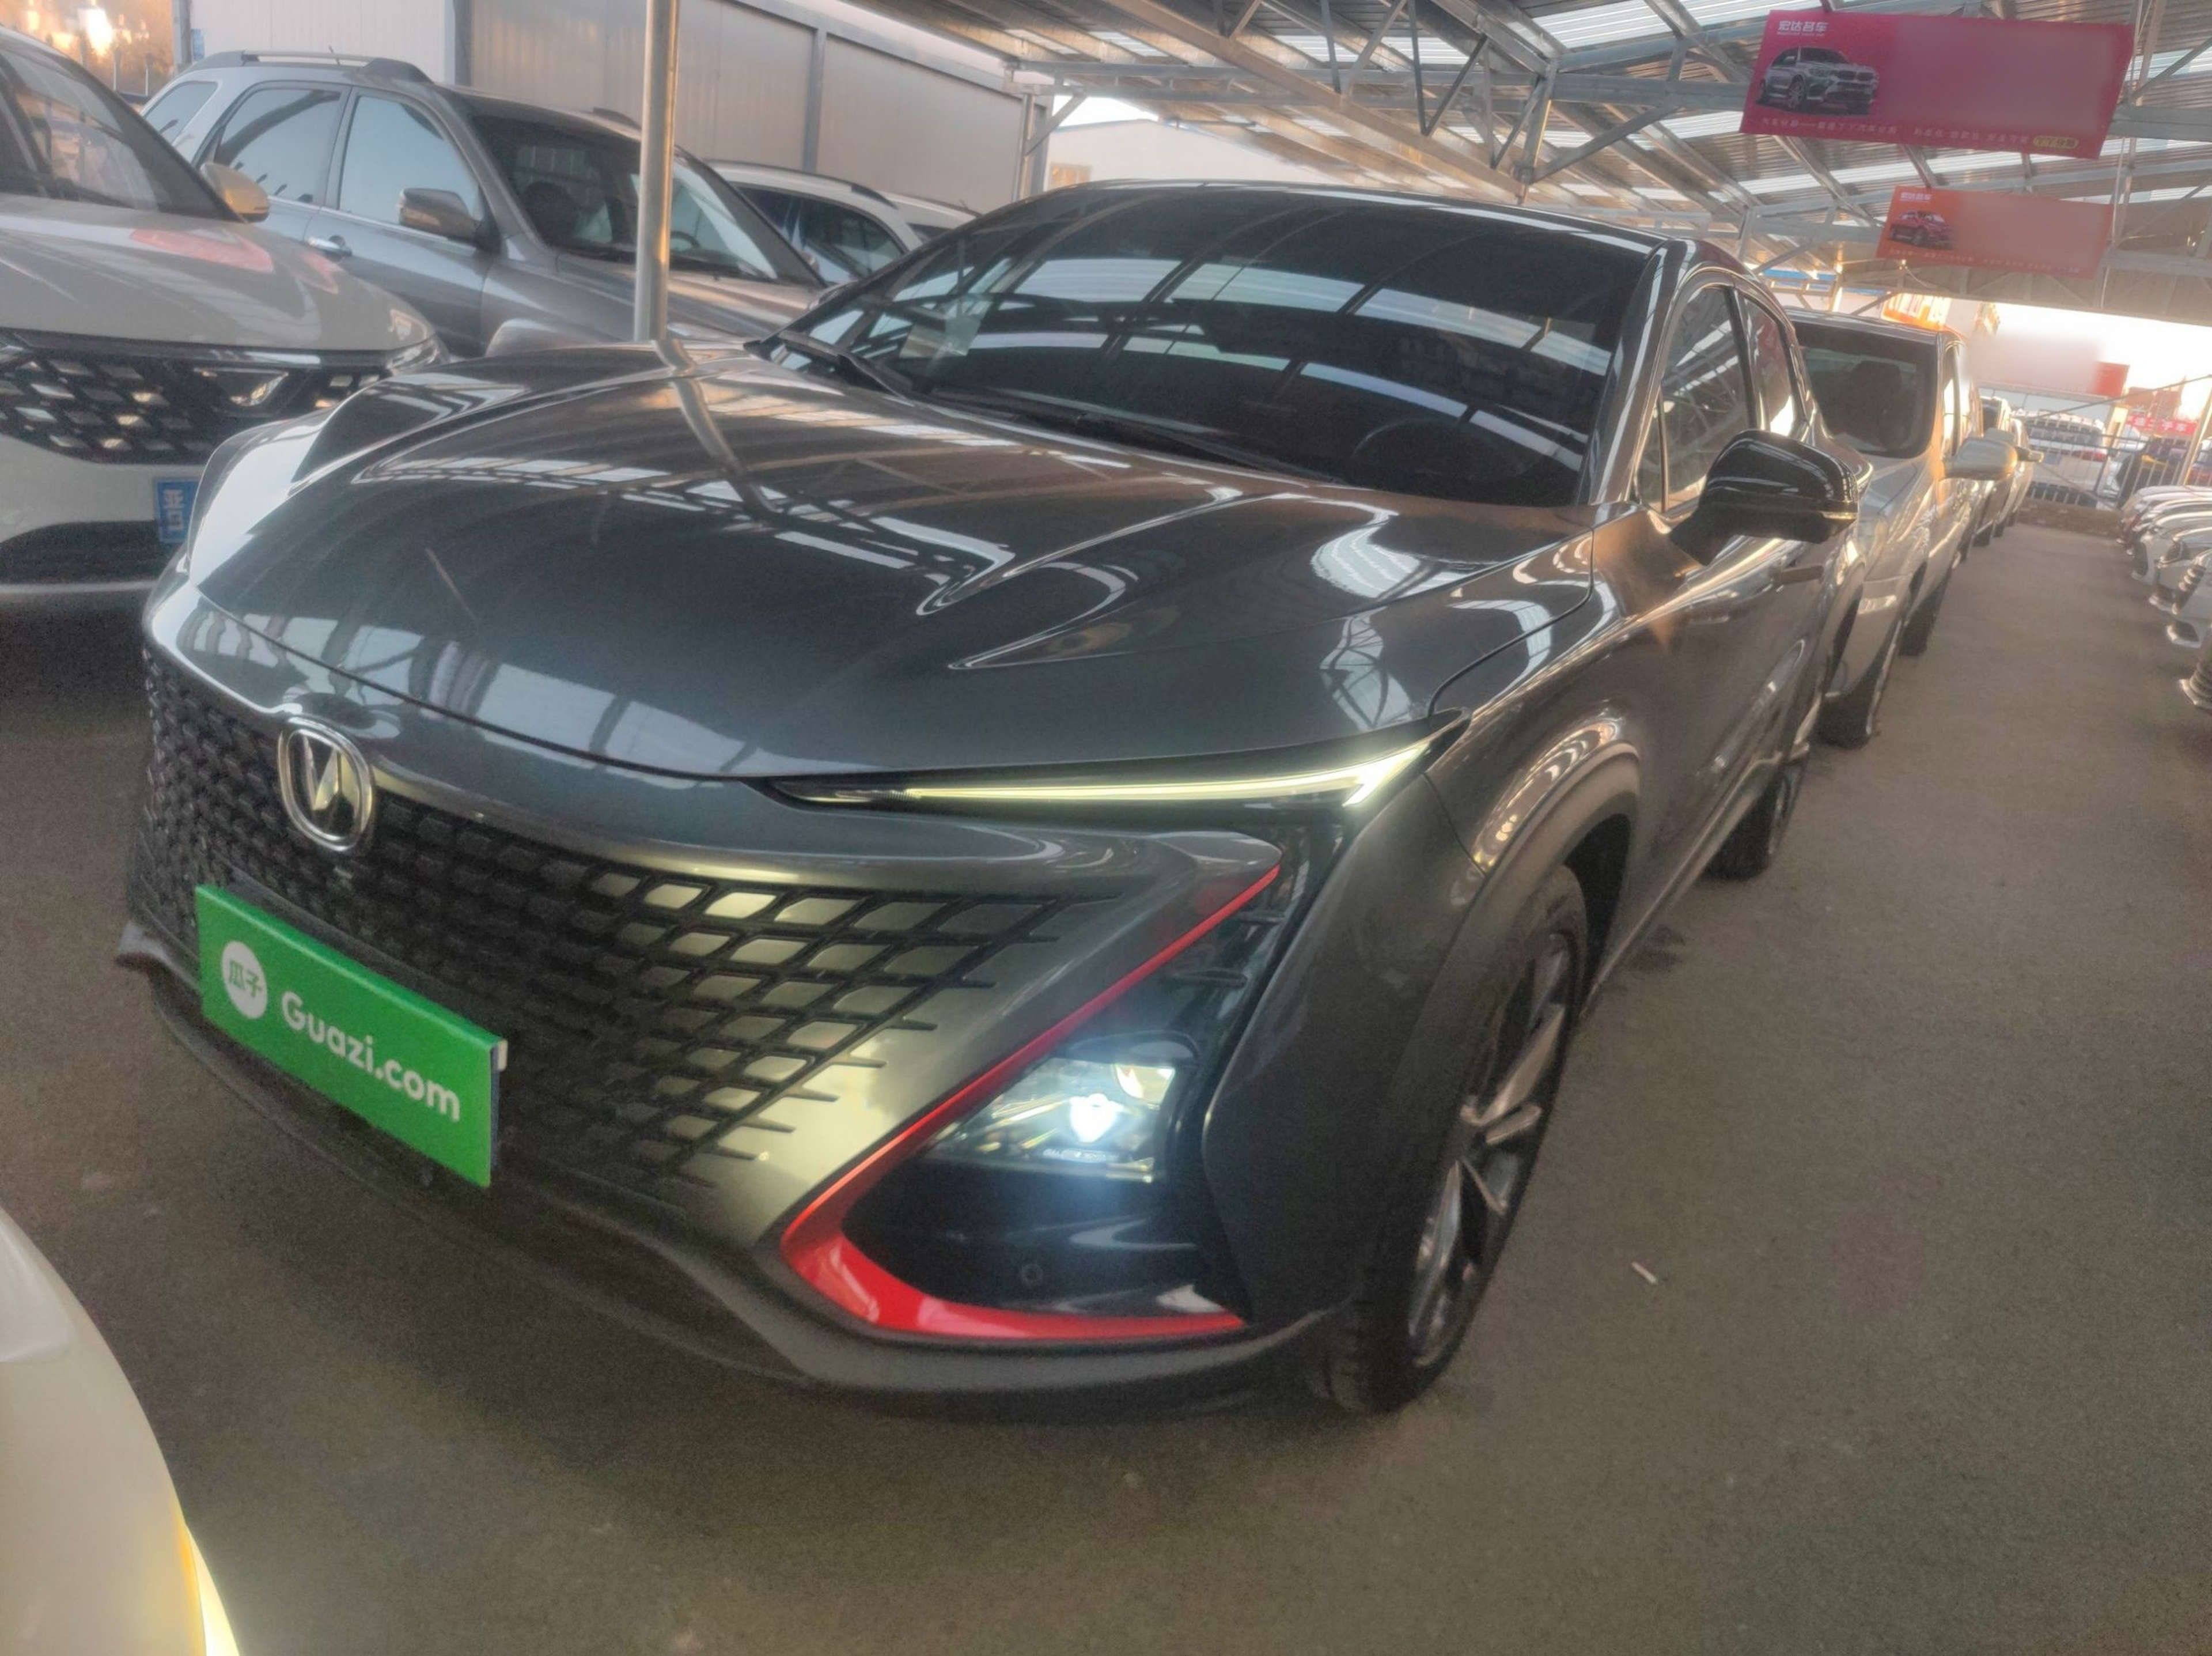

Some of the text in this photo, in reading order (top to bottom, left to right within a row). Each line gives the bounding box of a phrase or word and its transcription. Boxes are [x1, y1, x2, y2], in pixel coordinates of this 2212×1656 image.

[1777, 20, 1830, 32] 宏达名车
[229, 959, 263, 997] 瓜子
[281, 991, 460, 1122] Guazi.com
